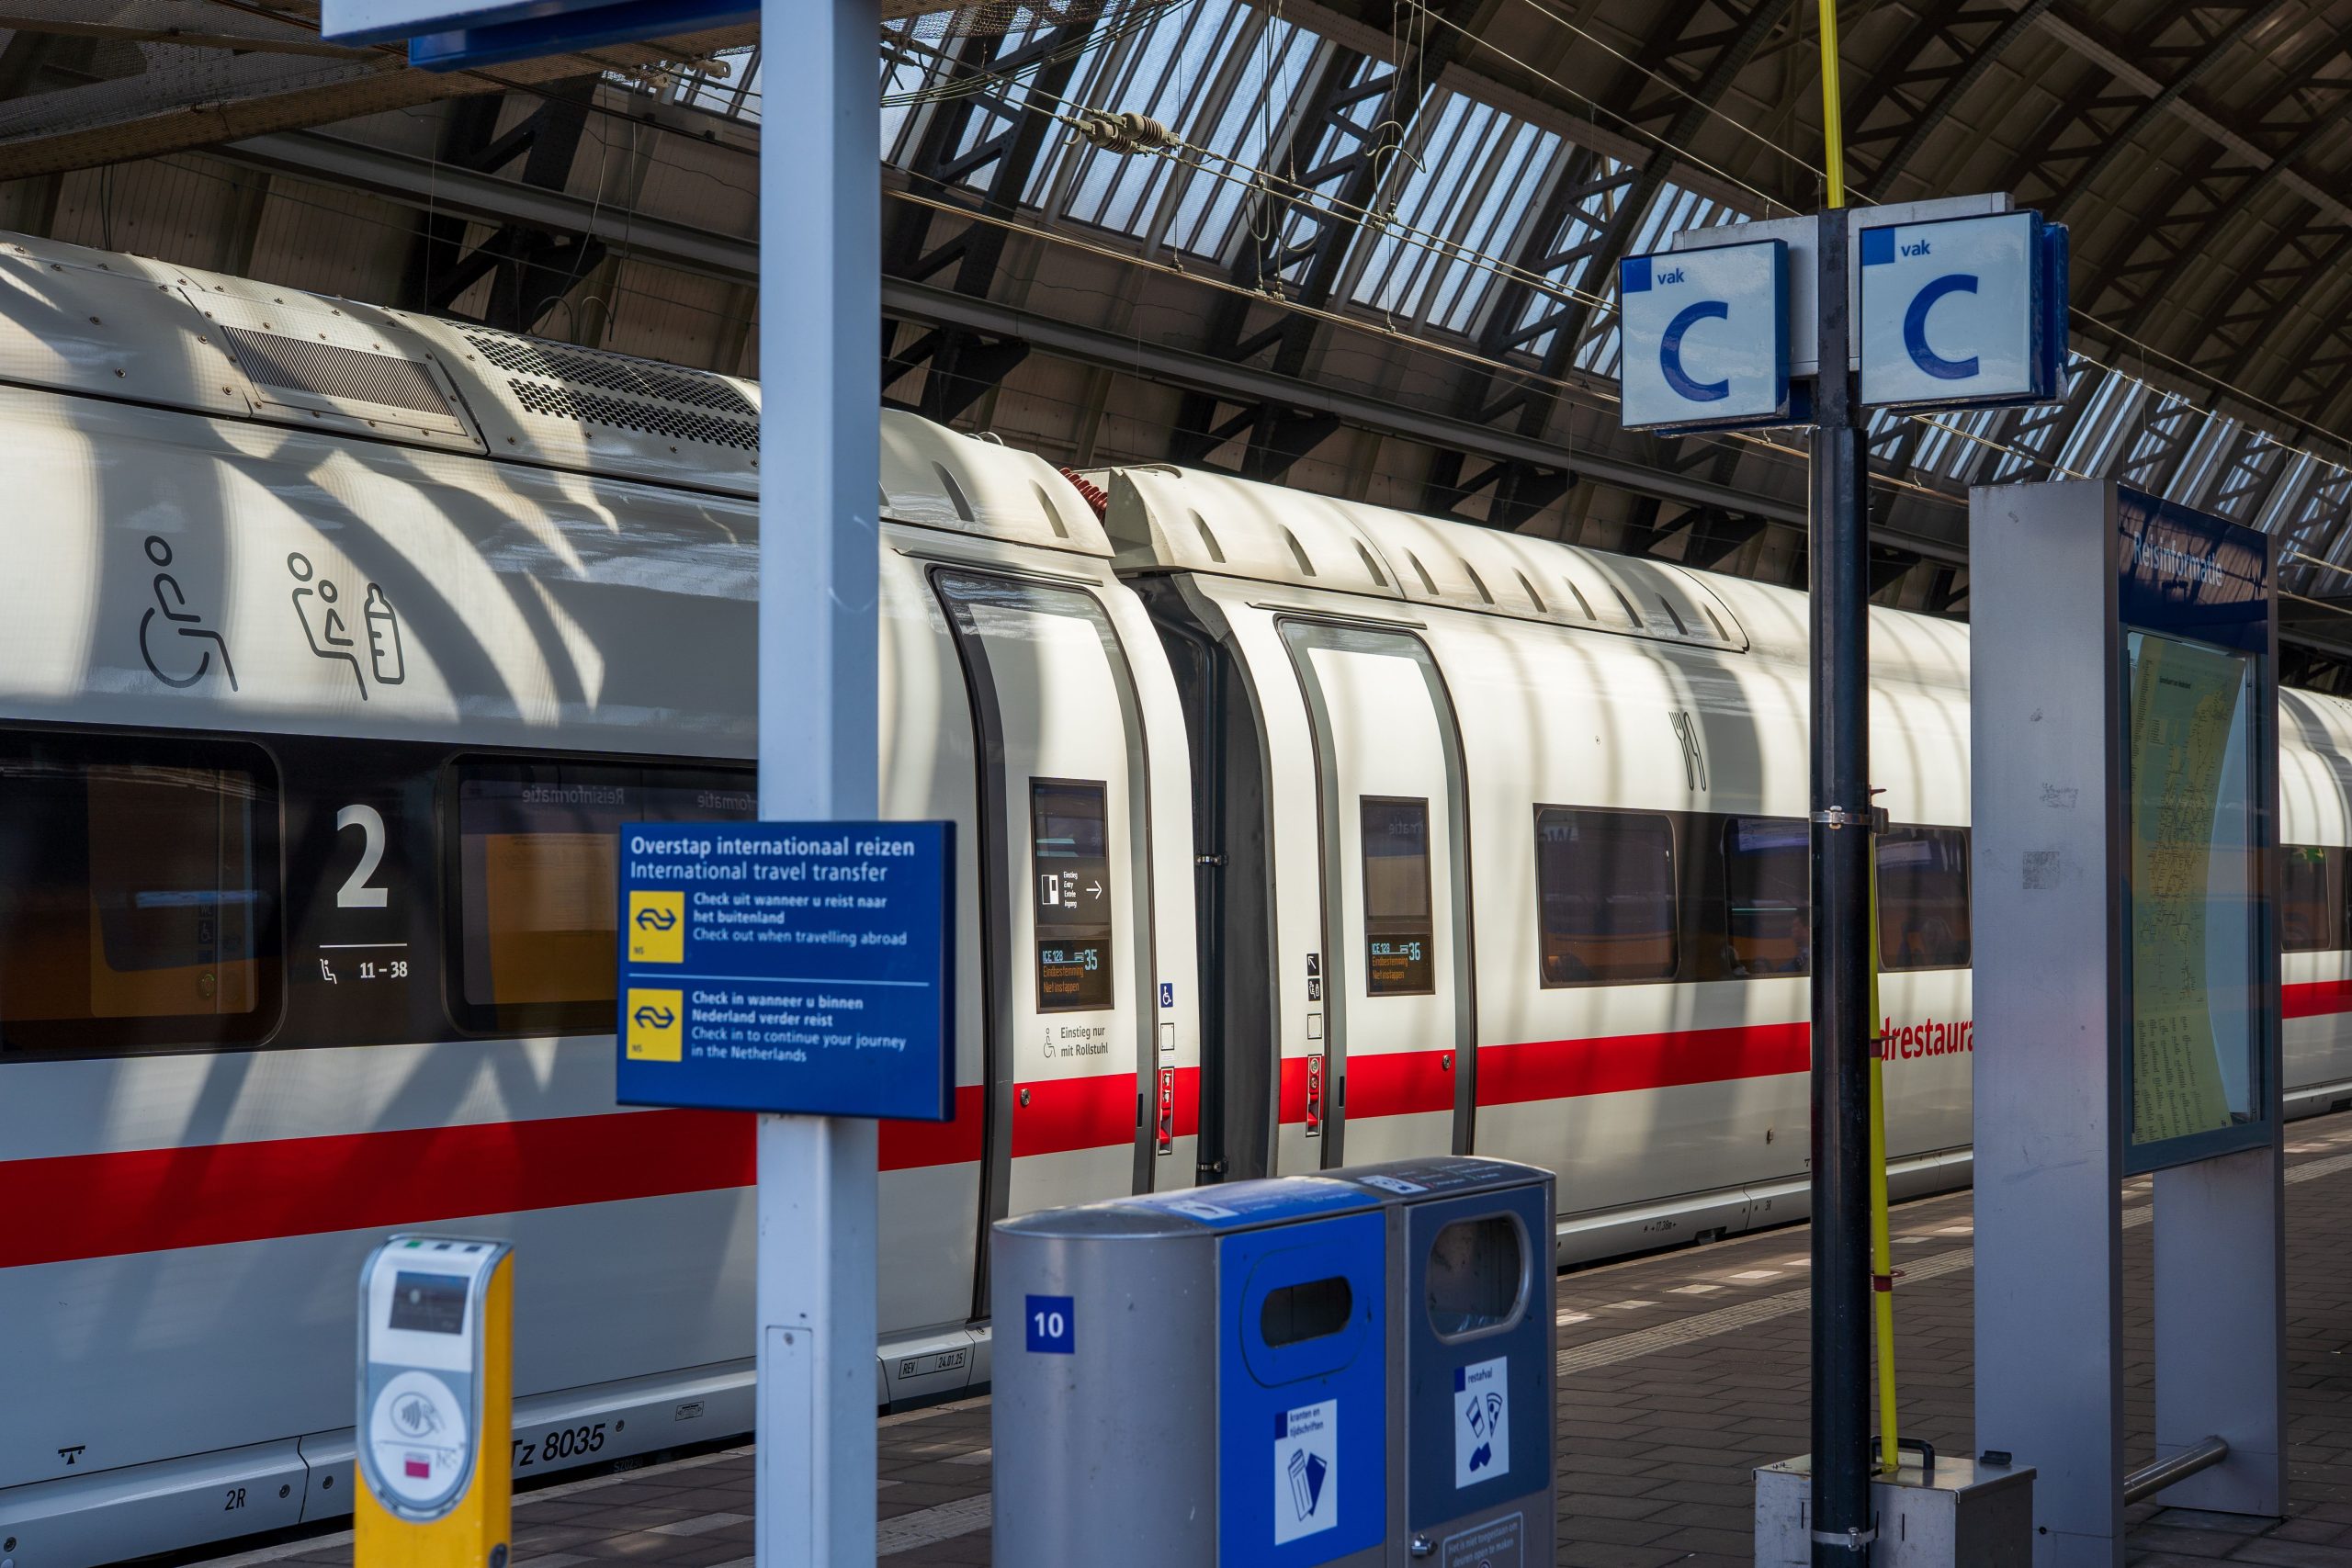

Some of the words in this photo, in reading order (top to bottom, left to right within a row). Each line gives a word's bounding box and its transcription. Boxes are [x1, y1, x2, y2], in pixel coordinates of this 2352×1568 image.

[1901, 240, 1931, 257] vak
[1657, 267, 1685, 285] vak
[1904, 274, 1980, 380] C
[1660, 300, 1730, 402] C
[2133, 531, 2222, 586] Reisinformatie
[337, 805, 388, 907] 2
[631, 837, 711, 859] Overstap
[717, 836, 849, 856] internationaal
[855, 837, 915, 857] reizen
[631, 861, 747, 880] International
[753, 862, 806, 881] travel
[813, 862, 888, 882] transfer
[694, 892, 729, 905] Check
[733, 893, 751, 906] uit
[753, 896, 809, 907] wanneer
[812, 896, 821, 907] u
[825, 894, 854, 908] reist
[857, 897, 888, 908] naar
[694, 909, 714, 923] het
[717, 910, 785, 924] buitenland
[693, 927, 729, 941] Check
[732, 930, 754, 942] out
[757, 928, 792, 942] when
[796, 930, 857, 948] travelling
[860, 931, 908, 946] abroad
[1042, 950, 1052, 962] ICE
[1084, 949, 1098, 970] 35
[1408, 942, 1420, 961] 36
[360, 962, 376, 978] 11
[390, 961, 408, 978] 38
[692, 991, 729, 1005] Check
[731, 992, 744, 1005] in
[747, 995, 803, 1008] wanneer
[806, 997, 815, 1008] u
[819, 995, 864, 1010] binnen
[692, 1010, 755, 1024] Nederland
[759, 1011, 800, 1025] verder
[804, 1013, 833, 1027] reist
[692, 1026, 728, 1040] Check
[731, 1028, 743, 1041] in
[747, 1029, 761, 1042] to
[763, 1031, 820, 1044] continue
[822, 1034, 853, 1048] your
[855, 1032, 907, 1052] journey
[1060, 1025, 1091, 1040] Einstieg
[1092, 1027, 1105, 1036] nur
[691, 1043, 704, 1056] in
[707, 1045, 728, 1058] the
[730, 1045, 807, 1062] Netherlands
[1060, 1044, 1073, 1056] mit
[1076, 1042, 1108, 1055] Rollstuhl
[1034, 1311, 1065, 1338] 10
[902, 1362, 916, 1375] REV
[511, 1438, 536, 1467] Tz
[542, 1423, 605, 1461] 8035
[224, 1488, 246, 1511] 2R
